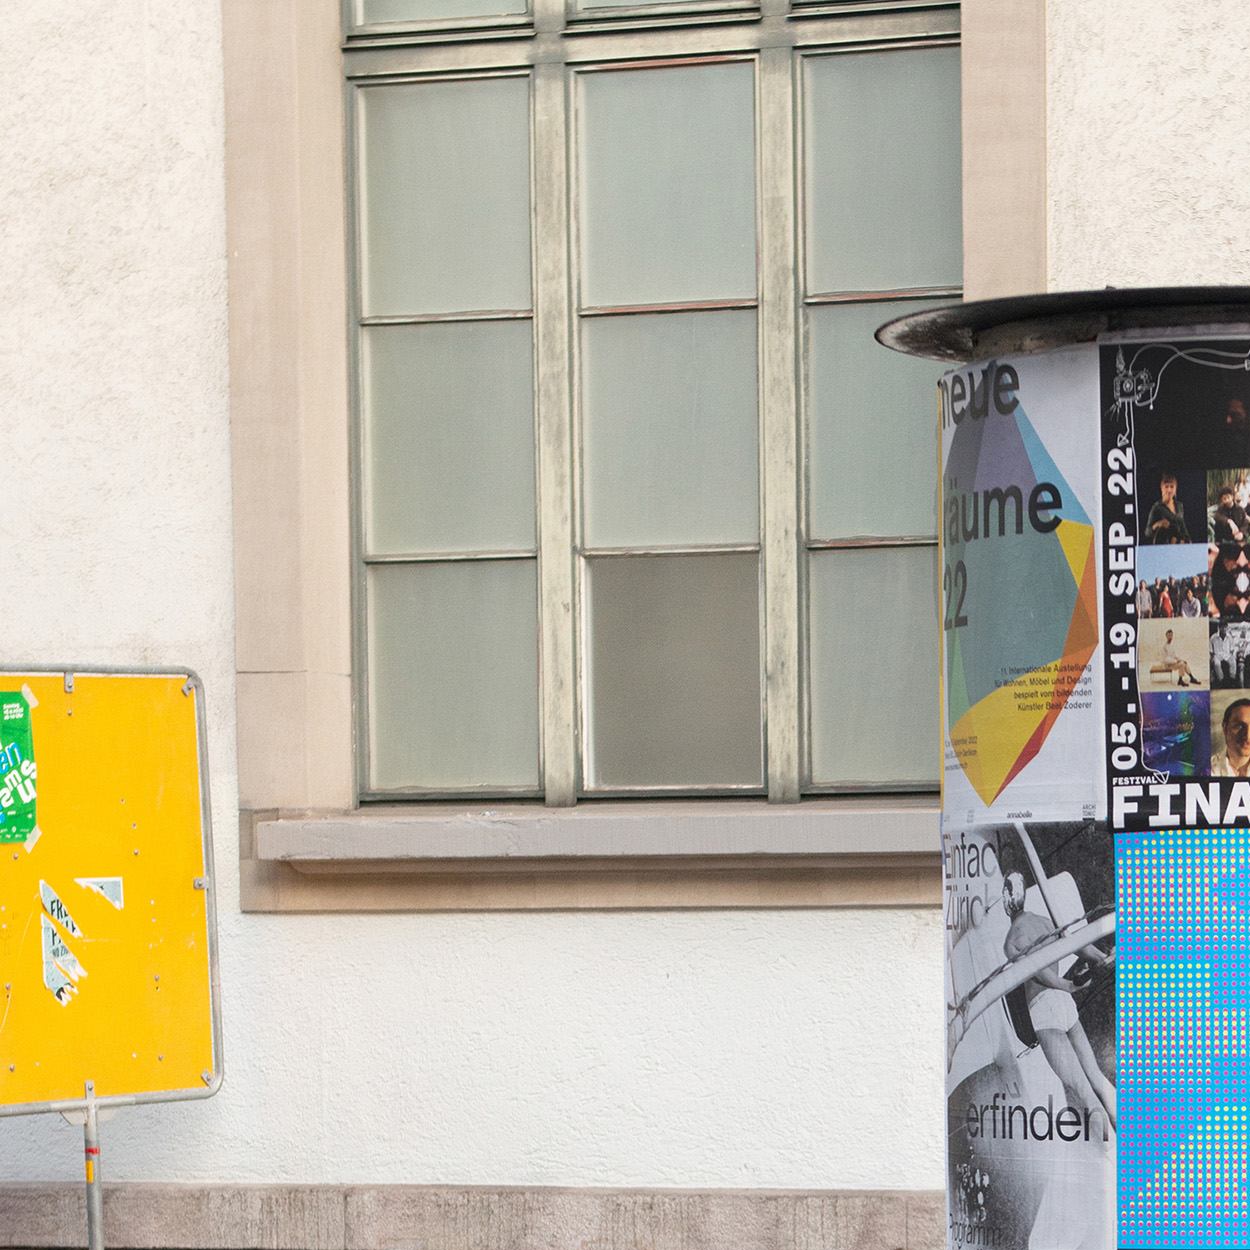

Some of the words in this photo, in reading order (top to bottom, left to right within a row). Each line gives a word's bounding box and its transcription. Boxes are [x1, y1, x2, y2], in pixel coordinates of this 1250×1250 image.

[942, 364, 1019, 429] neue
[1030, 677, 1050, 686] Möbel
[1052, 676, 1065, 685] und
[1067, 675, 1092, 686] Design
[1014, 692, 1038, 700] bespielt
[1041, 691, 1055, 699] vom
[1057, 689, 1092, 698] bildenden
[1018, 703, 1044, 711] Künstler
[1064, 702, 1092, 710] Zoderer
[1112, 776, 1158, 786] FESTIVAL
[1007, 810, 1033, 819] annabelle
[967, 1094, 1109, 1142] erfinden
